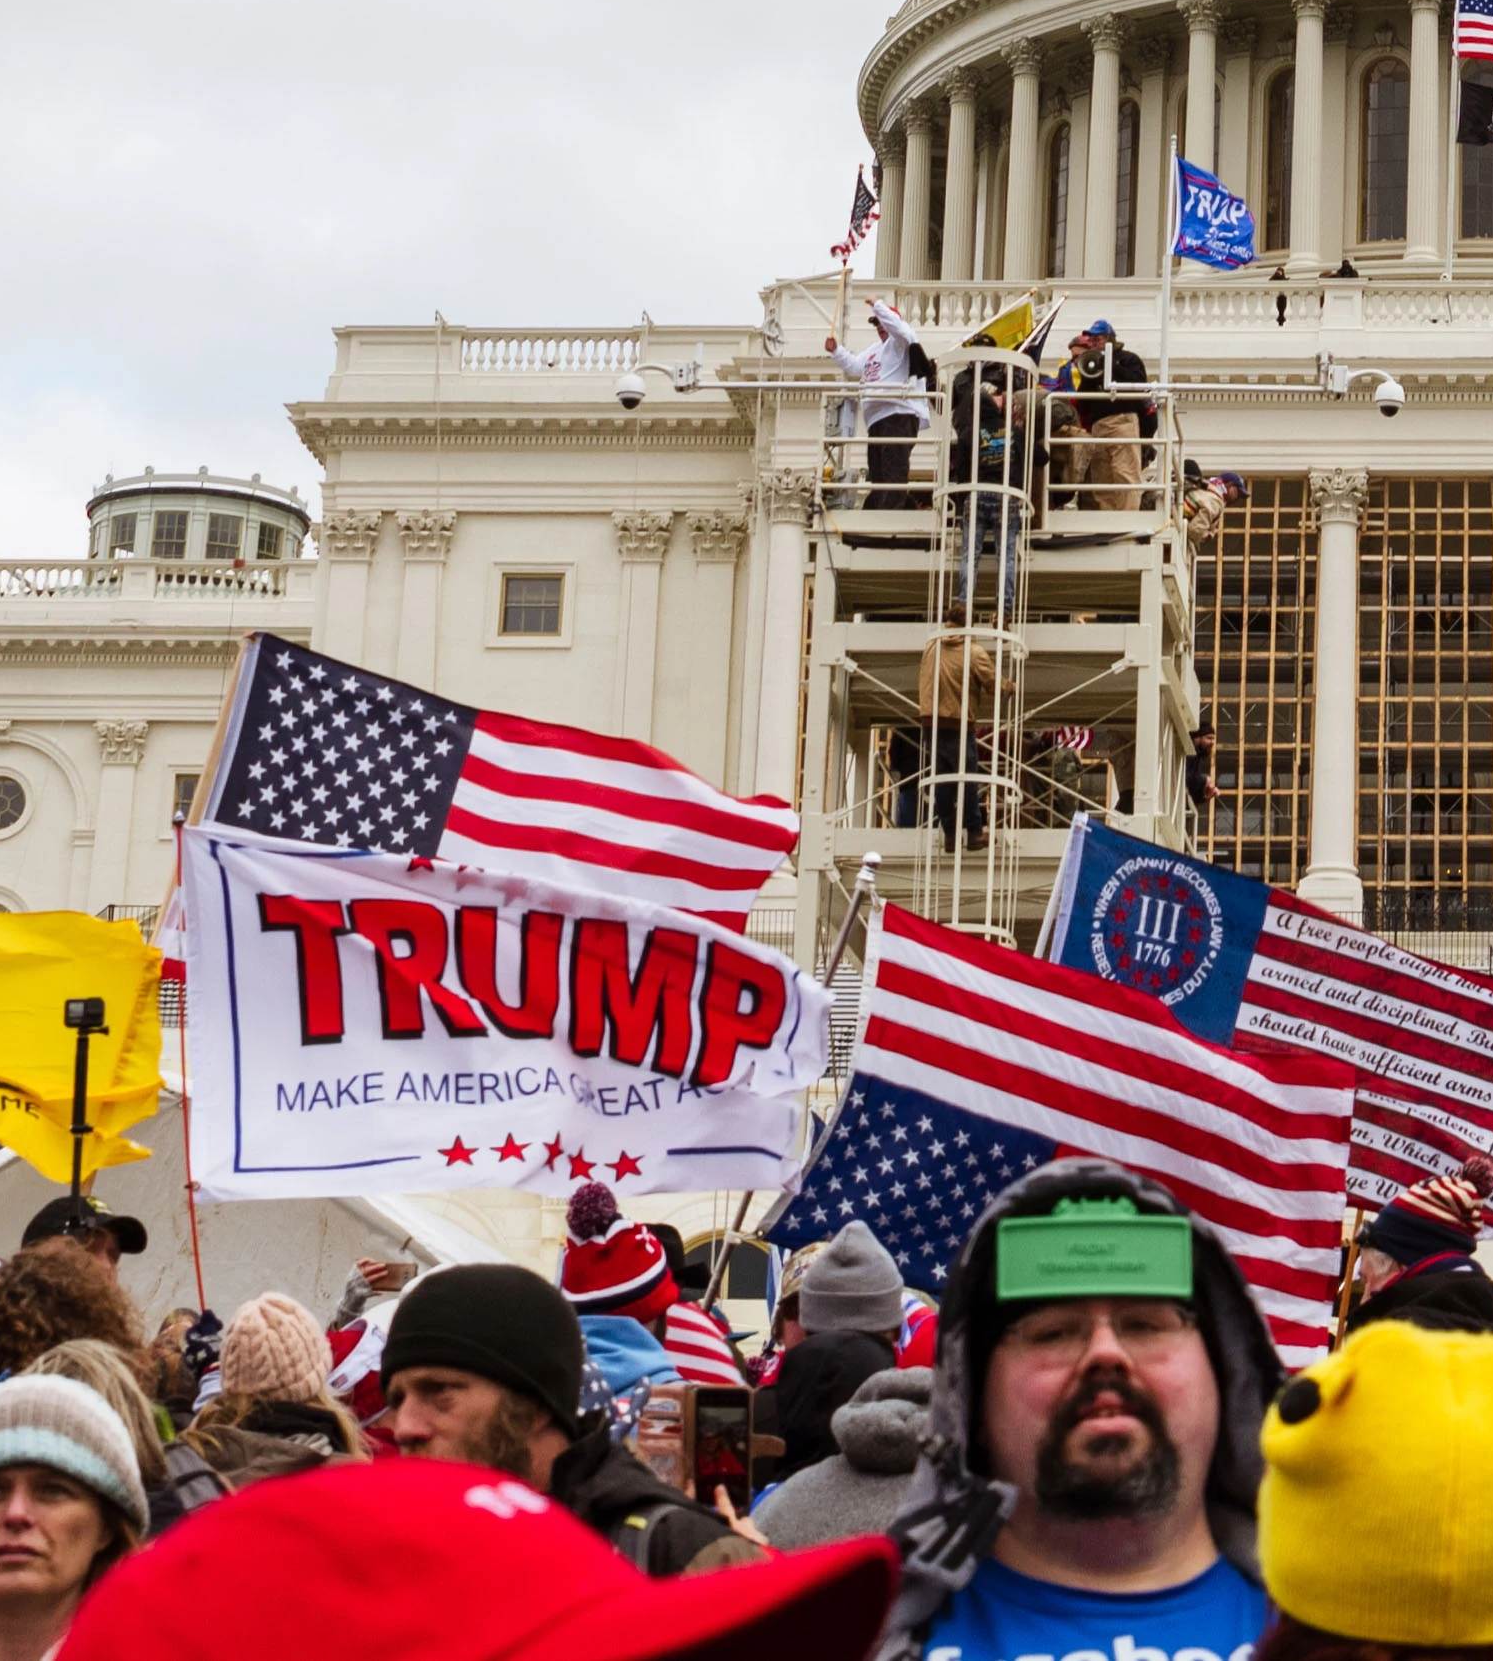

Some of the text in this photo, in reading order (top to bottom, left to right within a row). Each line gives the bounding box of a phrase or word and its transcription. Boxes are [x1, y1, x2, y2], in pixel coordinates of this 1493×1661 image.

[1092, 856, 1224, 951] WHEN TYRANNY BECOMES LAW
[1134, 894, 1185, 945] III
[1134, 940, 1172, 968] 1776
[1276, 912, 1293, 930] A
[1296, 919, 1333, 943] free
[1335, 934, 1396, 961] people
[257, 892, 788, 1089] TRUMP
[1183, 956, 1214, 996] DUTY
[1260, 964, 1322, 995] armed
[1324, 985, 1359, 1007] and
[1362, 993, 1460, 1043] disciplined,
[1249, 1012, 1318, 1042] should
[1319, 1027, 1356, 1057] have
[1357, 1046, 1442, 1087] sufficient
[1444, 1079, 1493, 1103] arms
[1, 1095, 41, 1120] ME
[276, 1072, 385, 1114] MAKE
[395, 1066, 565, 1106] AMERICA
[1382, 1132, 1441, 1171] Which
